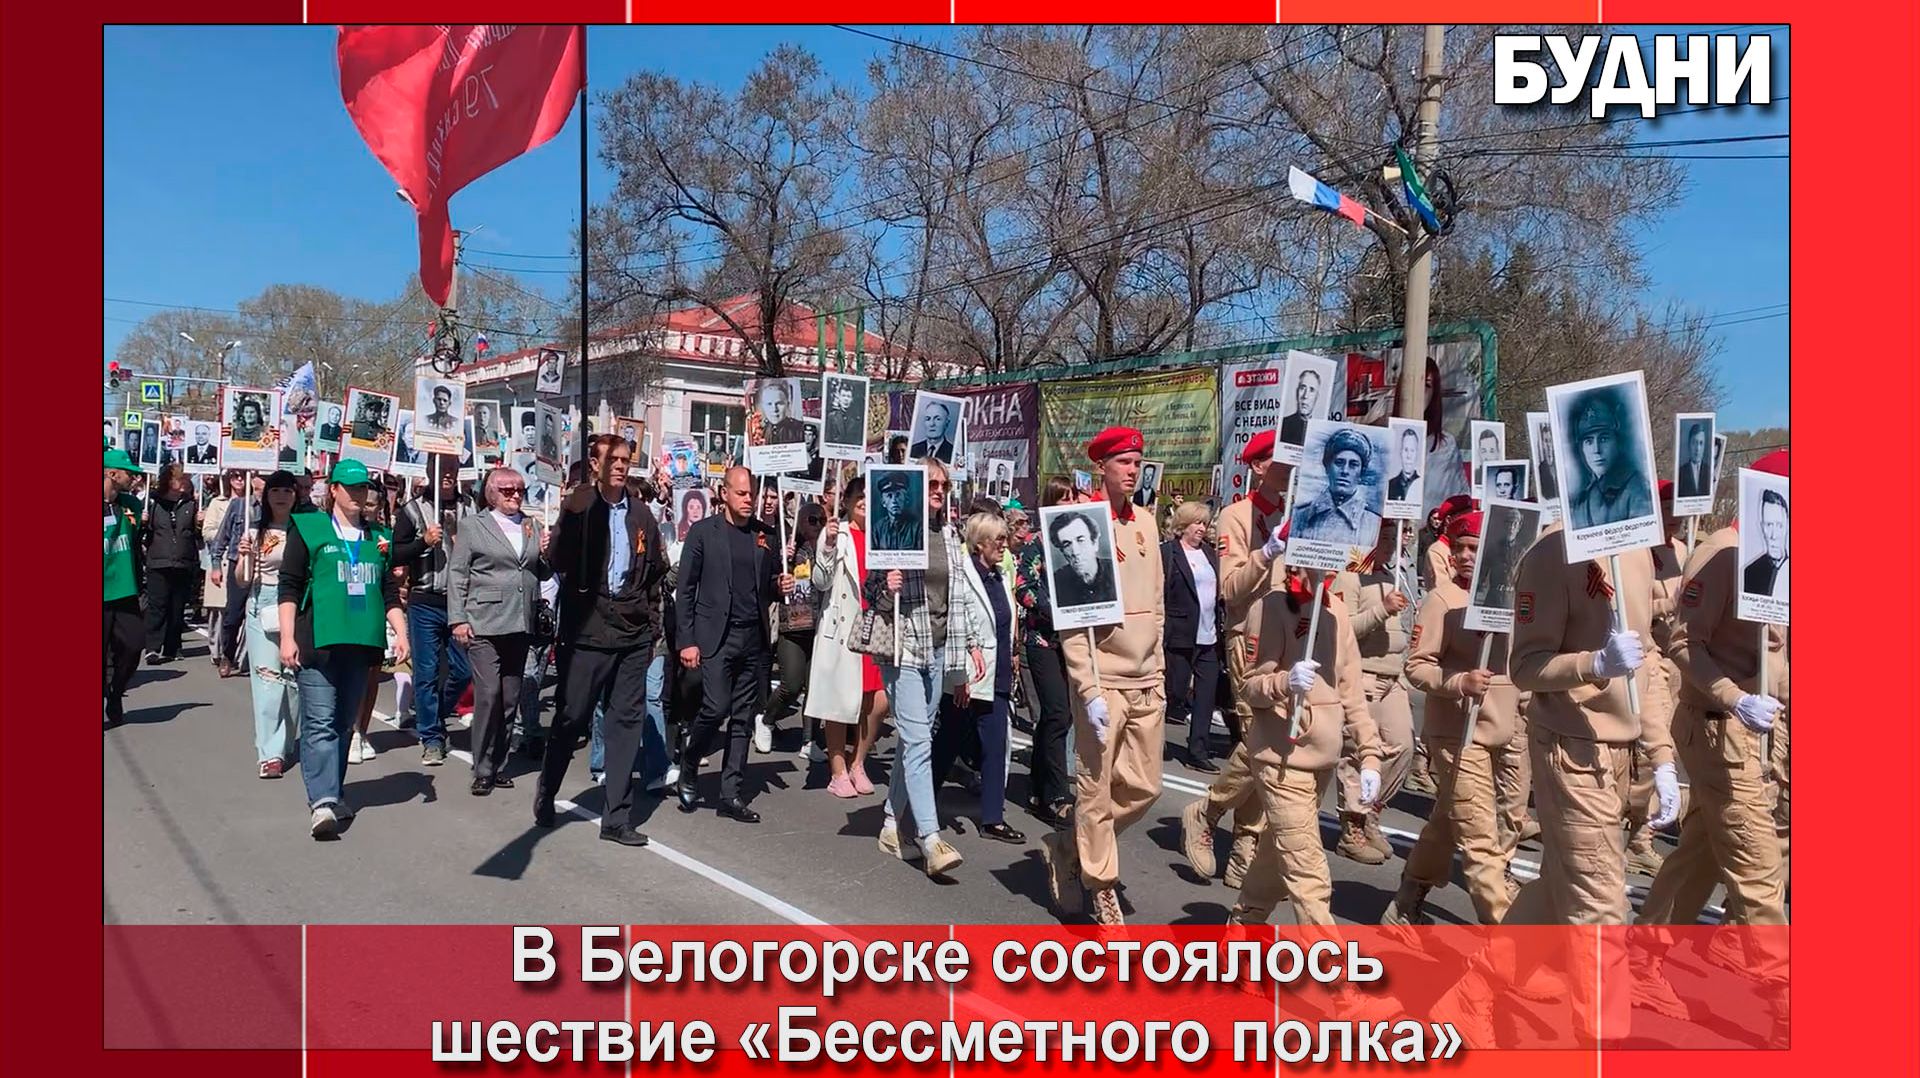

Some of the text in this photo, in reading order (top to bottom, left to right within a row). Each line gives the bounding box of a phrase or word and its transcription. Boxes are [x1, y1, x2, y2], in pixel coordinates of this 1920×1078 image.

[1235, 399, 1253, 411] ВСЕ
[1235, 414, 1279, 427] С НЕДВИ
